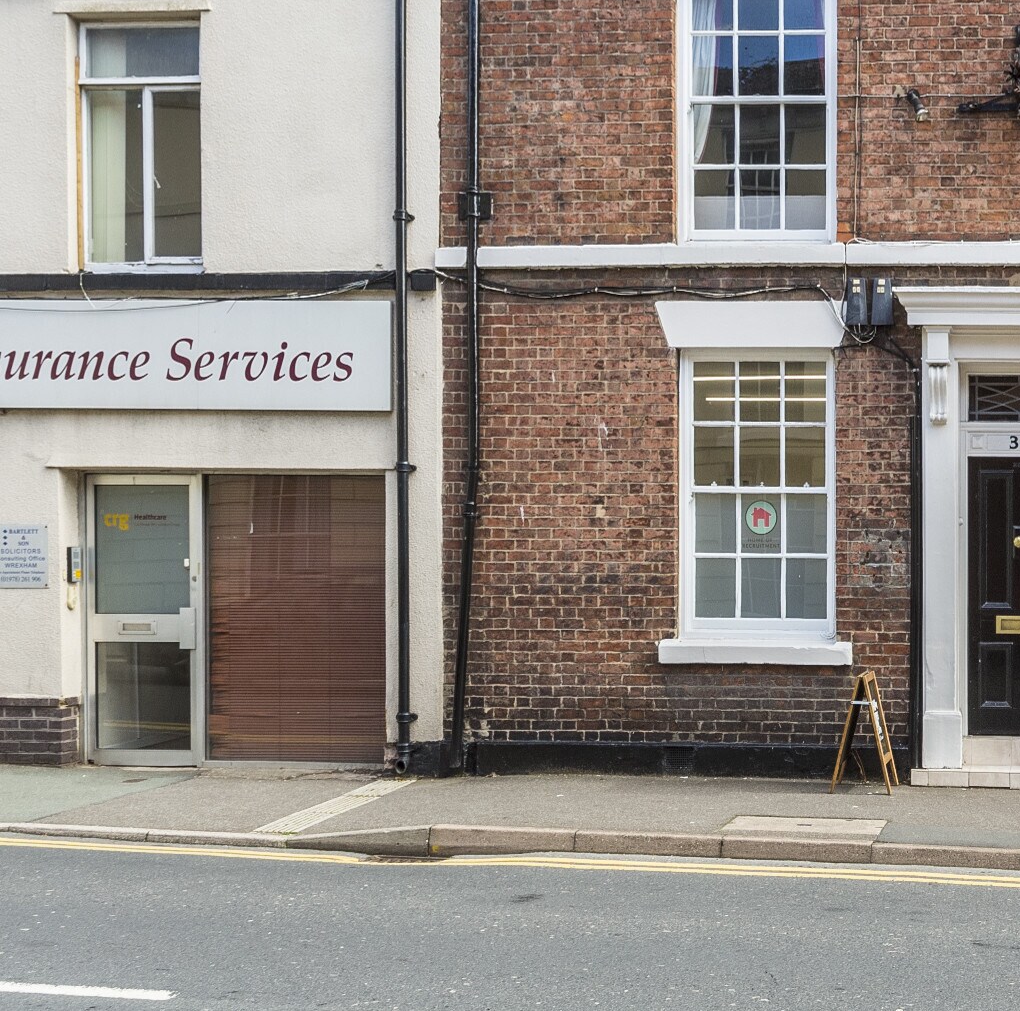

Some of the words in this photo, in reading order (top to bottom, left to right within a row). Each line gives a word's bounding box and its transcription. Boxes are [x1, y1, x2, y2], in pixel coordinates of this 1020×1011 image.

[0, 350, 151, 381] urance
[165, 337, 354, 383] Services
[133, 513, 167, 521] Healthcare
